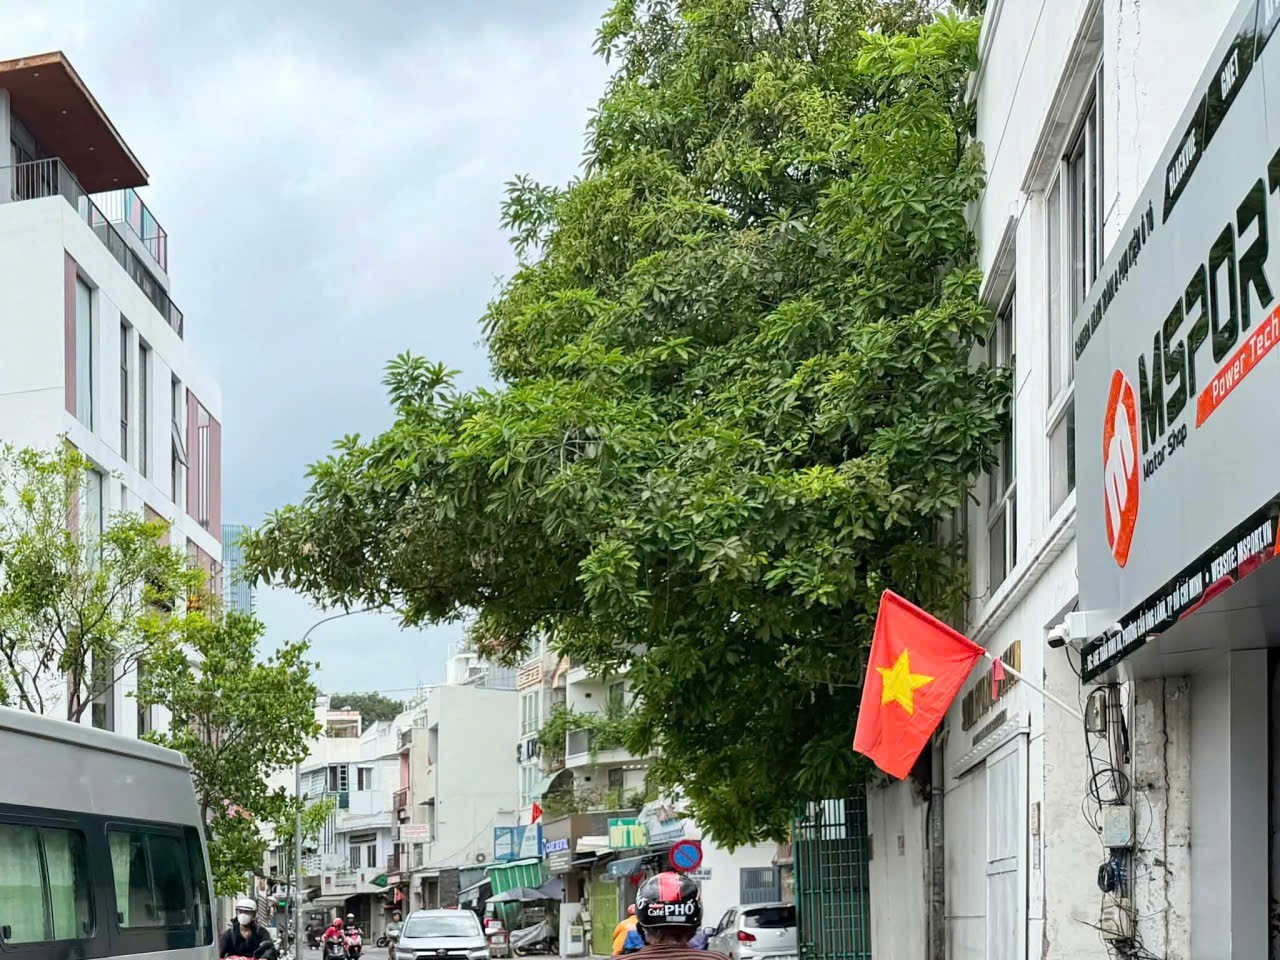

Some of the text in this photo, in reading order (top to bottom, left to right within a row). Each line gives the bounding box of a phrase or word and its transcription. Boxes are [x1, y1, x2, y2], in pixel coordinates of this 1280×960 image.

[1212, 313, 1279, 405] Power Tech
[1143, 423, 1188, 482] Motor Shop
[648, 899, 694, 916] Café PHỐ
